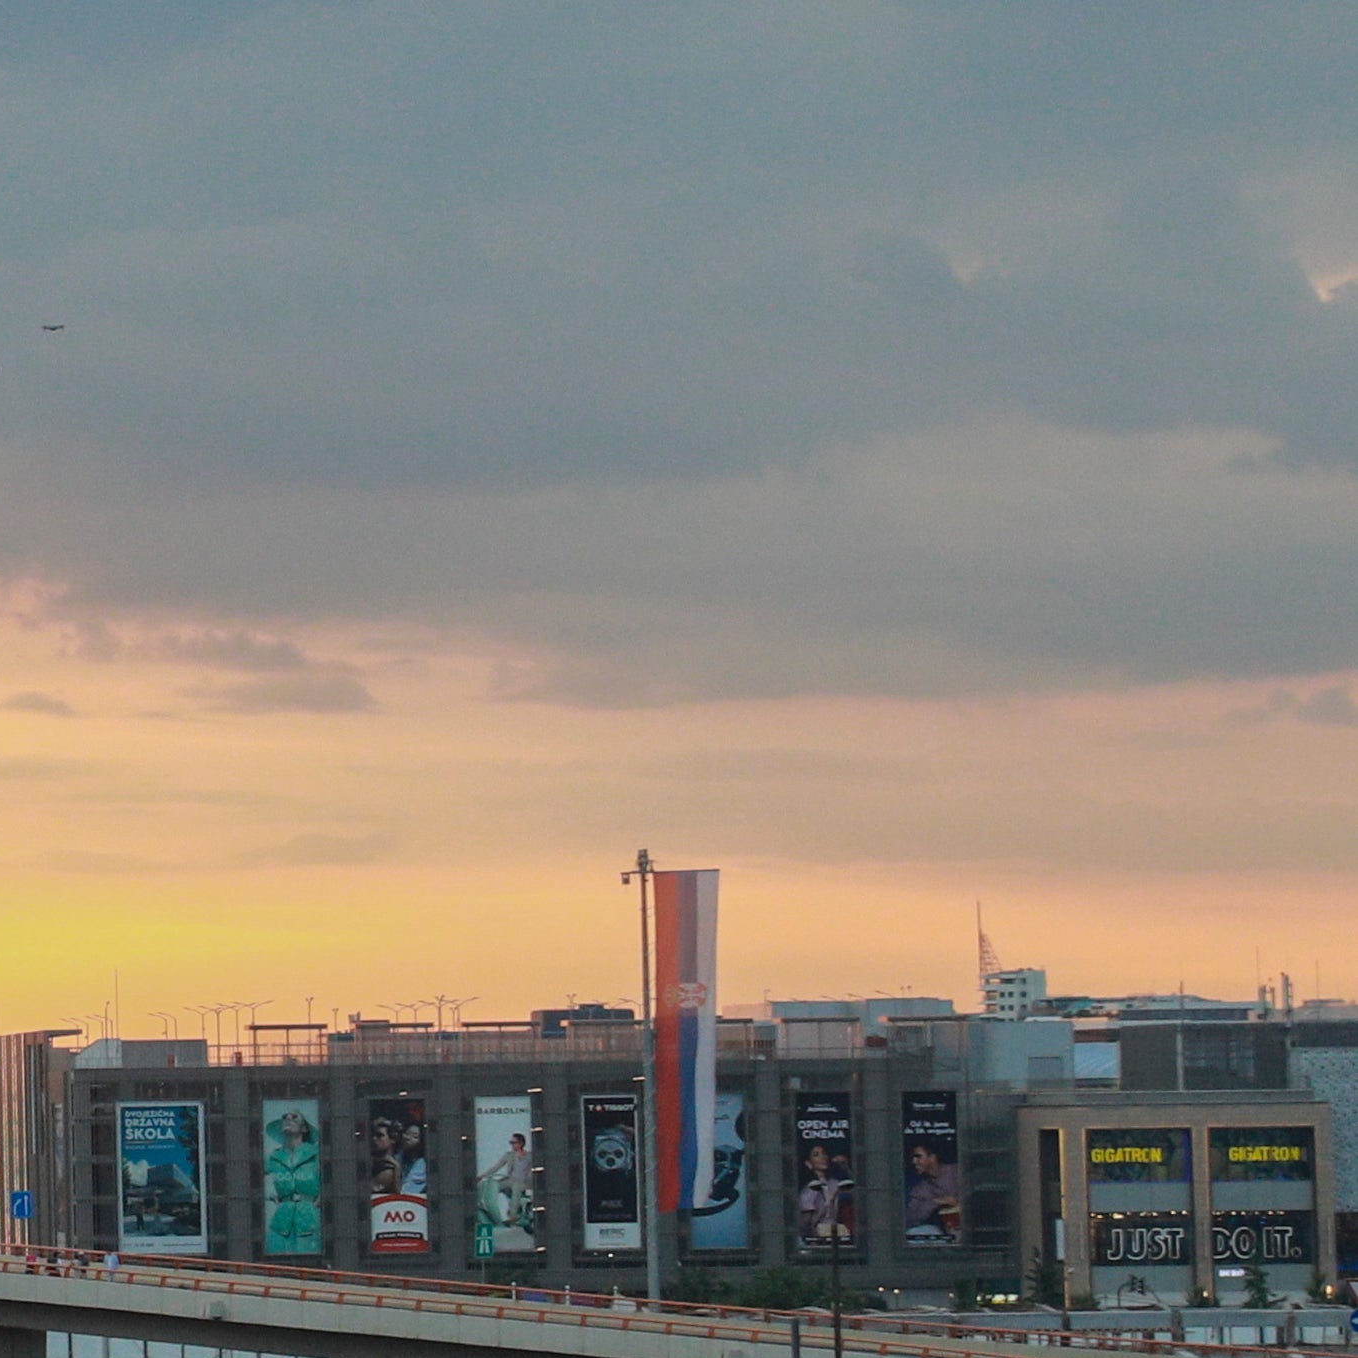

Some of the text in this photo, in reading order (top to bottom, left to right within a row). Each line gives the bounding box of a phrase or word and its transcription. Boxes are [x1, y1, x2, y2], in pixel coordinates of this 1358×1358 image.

[604, 1104, 635, 1112] TISSOT
[797, 1120, 849, 1129] OPEN AIR
[125, 1126, 176, 1140] ŠKOLA
[802, 1130, 846, 1139] CINEMA
[1091, 1147, 1163, 1163] GIGATRON
[1229, 1145, 1301, 1162] GIGATRON
[1107, 1228, 1185, 1261] JUST
[1212, 1226, 1258, 1260] DO
